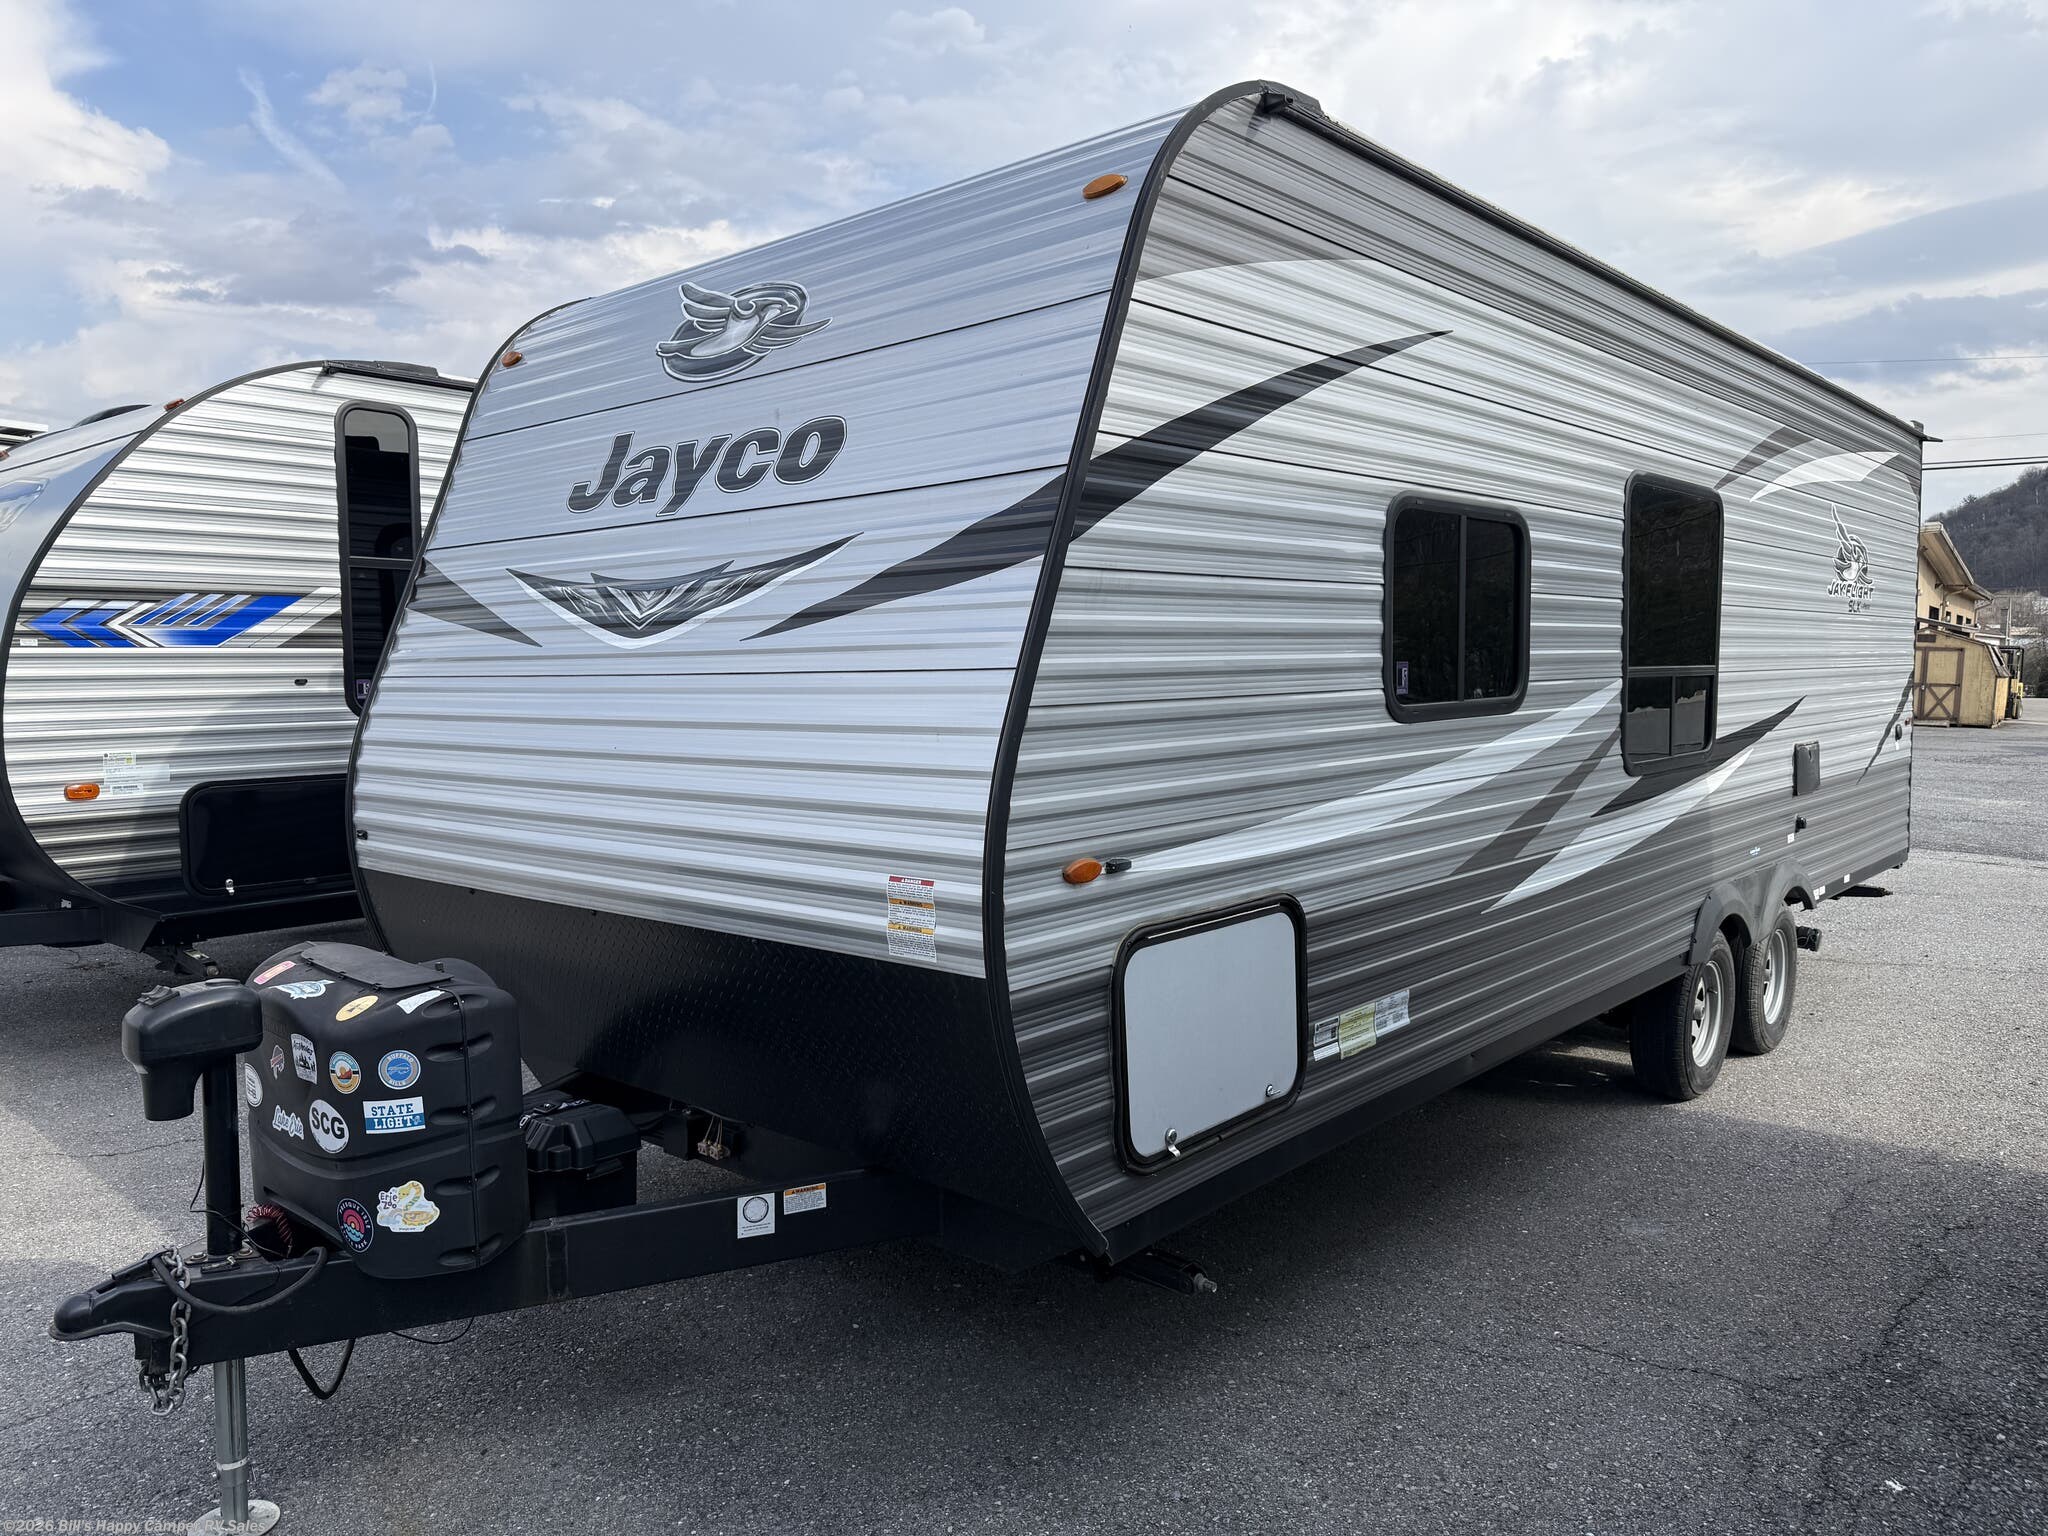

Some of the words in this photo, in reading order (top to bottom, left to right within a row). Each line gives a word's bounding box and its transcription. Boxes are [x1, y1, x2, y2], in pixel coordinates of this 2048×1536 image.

[566, 416, 847, 517] Jayco
[371, 1103, 414, 1117] STATE
[311, 1106, 346, 1140] SCG
[374, 1115, 413, 1129] LIGHT
[380, 1191, 398, 1202] Erie
[381, 1201, 397, 1210] Zoo
